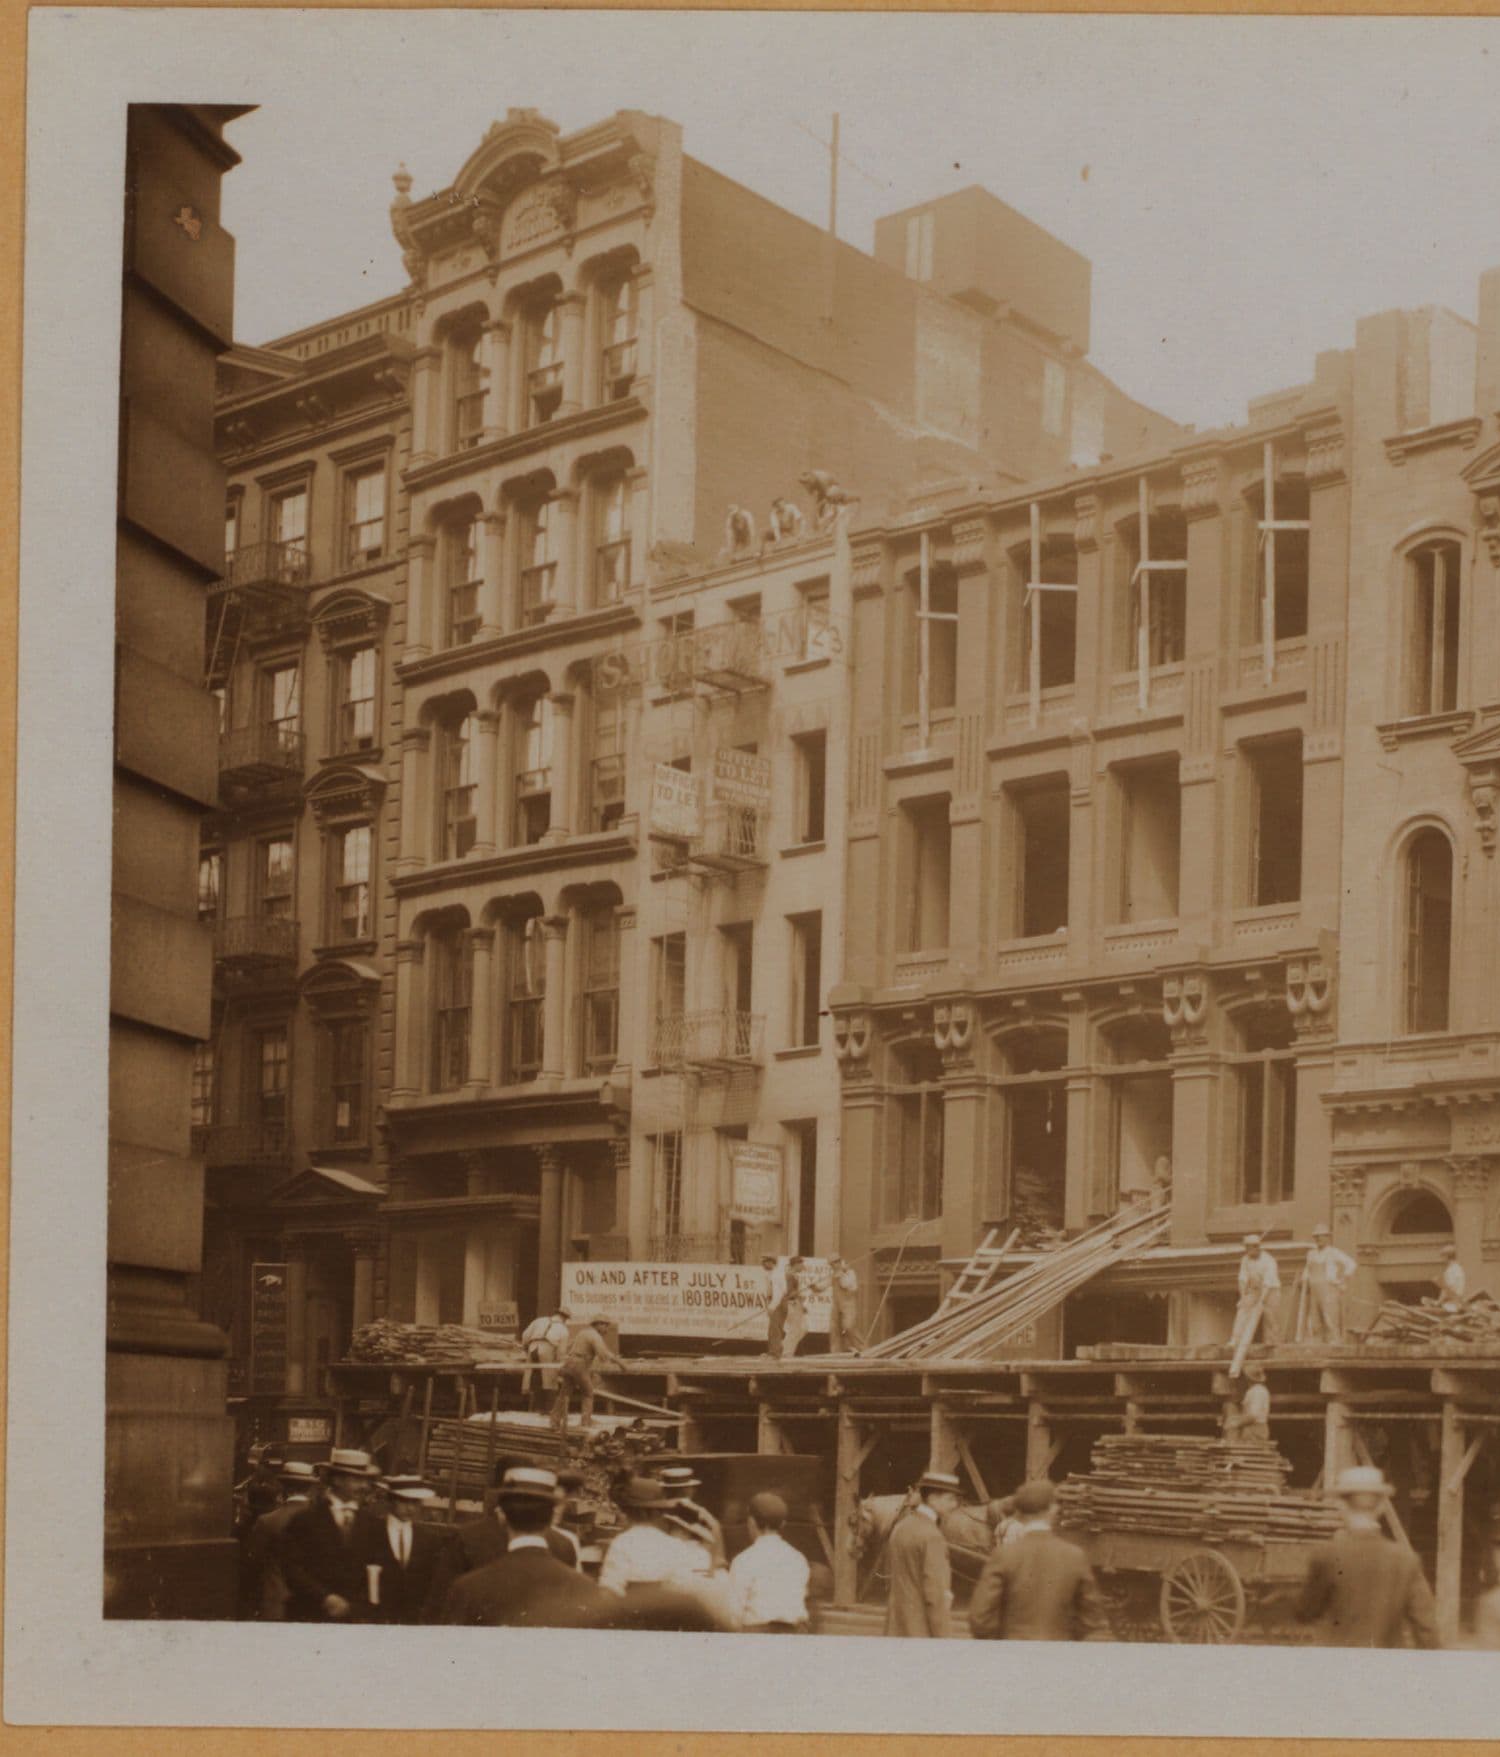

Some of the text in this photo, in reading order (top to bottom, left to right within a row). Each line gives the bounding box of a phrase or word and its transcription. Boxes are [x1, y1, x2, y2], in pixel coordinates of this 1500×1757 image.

[575, 1270, 594, 1285] ON
[600, 1271, 626, 1285] AND
[633, 1271, 679, 1286] AFTER
[687, 1272, 725, 1288] JULY
[682, 1290, 702, 1307] 180
[704, 1290, 770, 1310] BROADWAY
